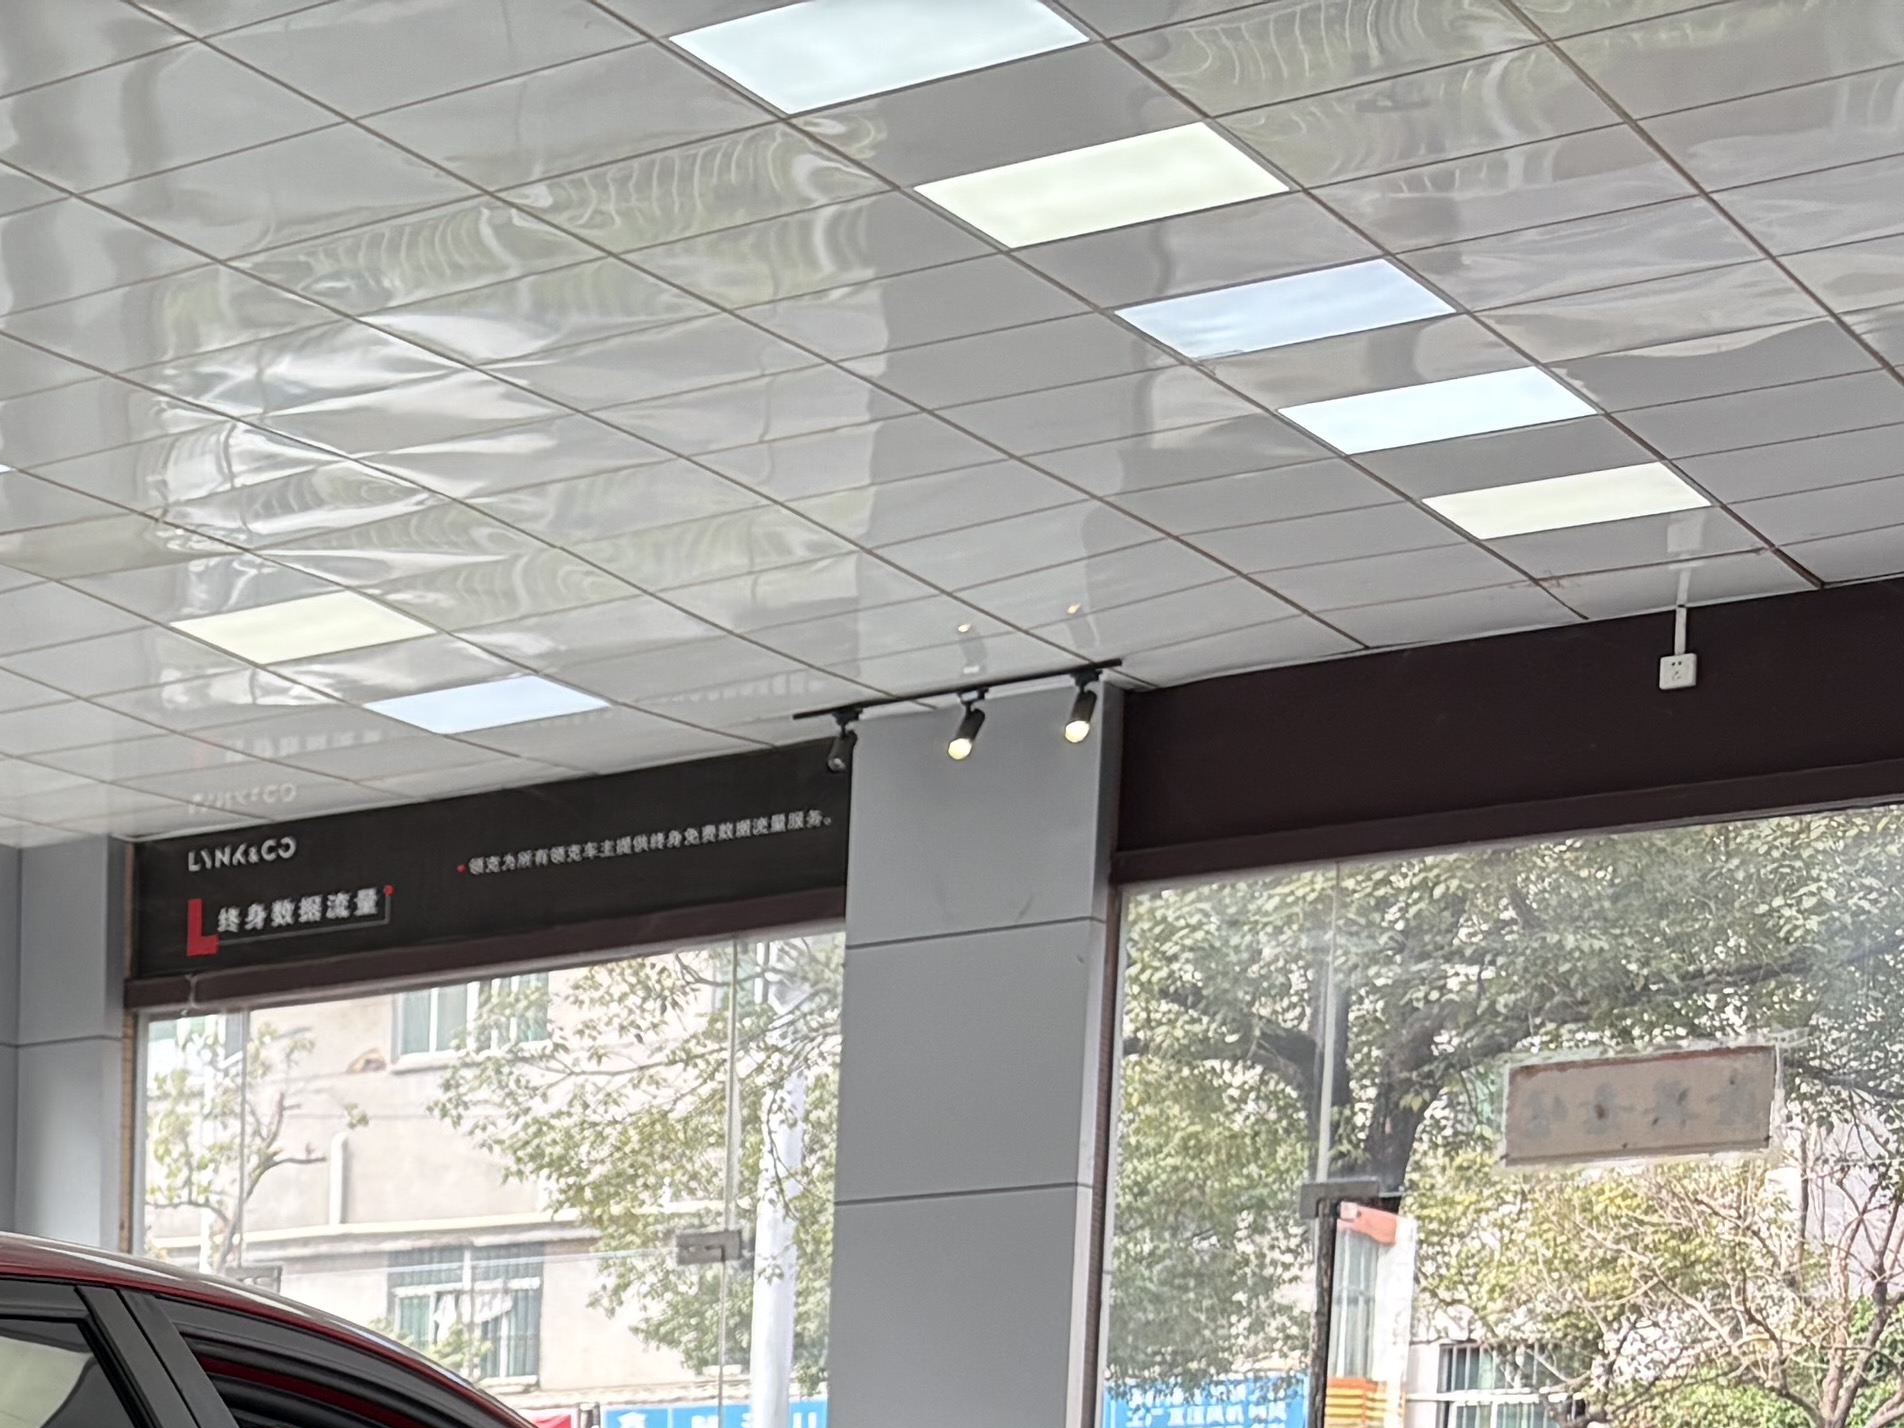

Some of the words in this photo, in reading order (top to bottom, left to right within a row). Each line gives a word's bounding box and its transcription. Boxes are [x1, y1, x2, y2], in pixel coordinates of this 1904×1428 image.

[217, 886, 379, 933] 终身数据流量
